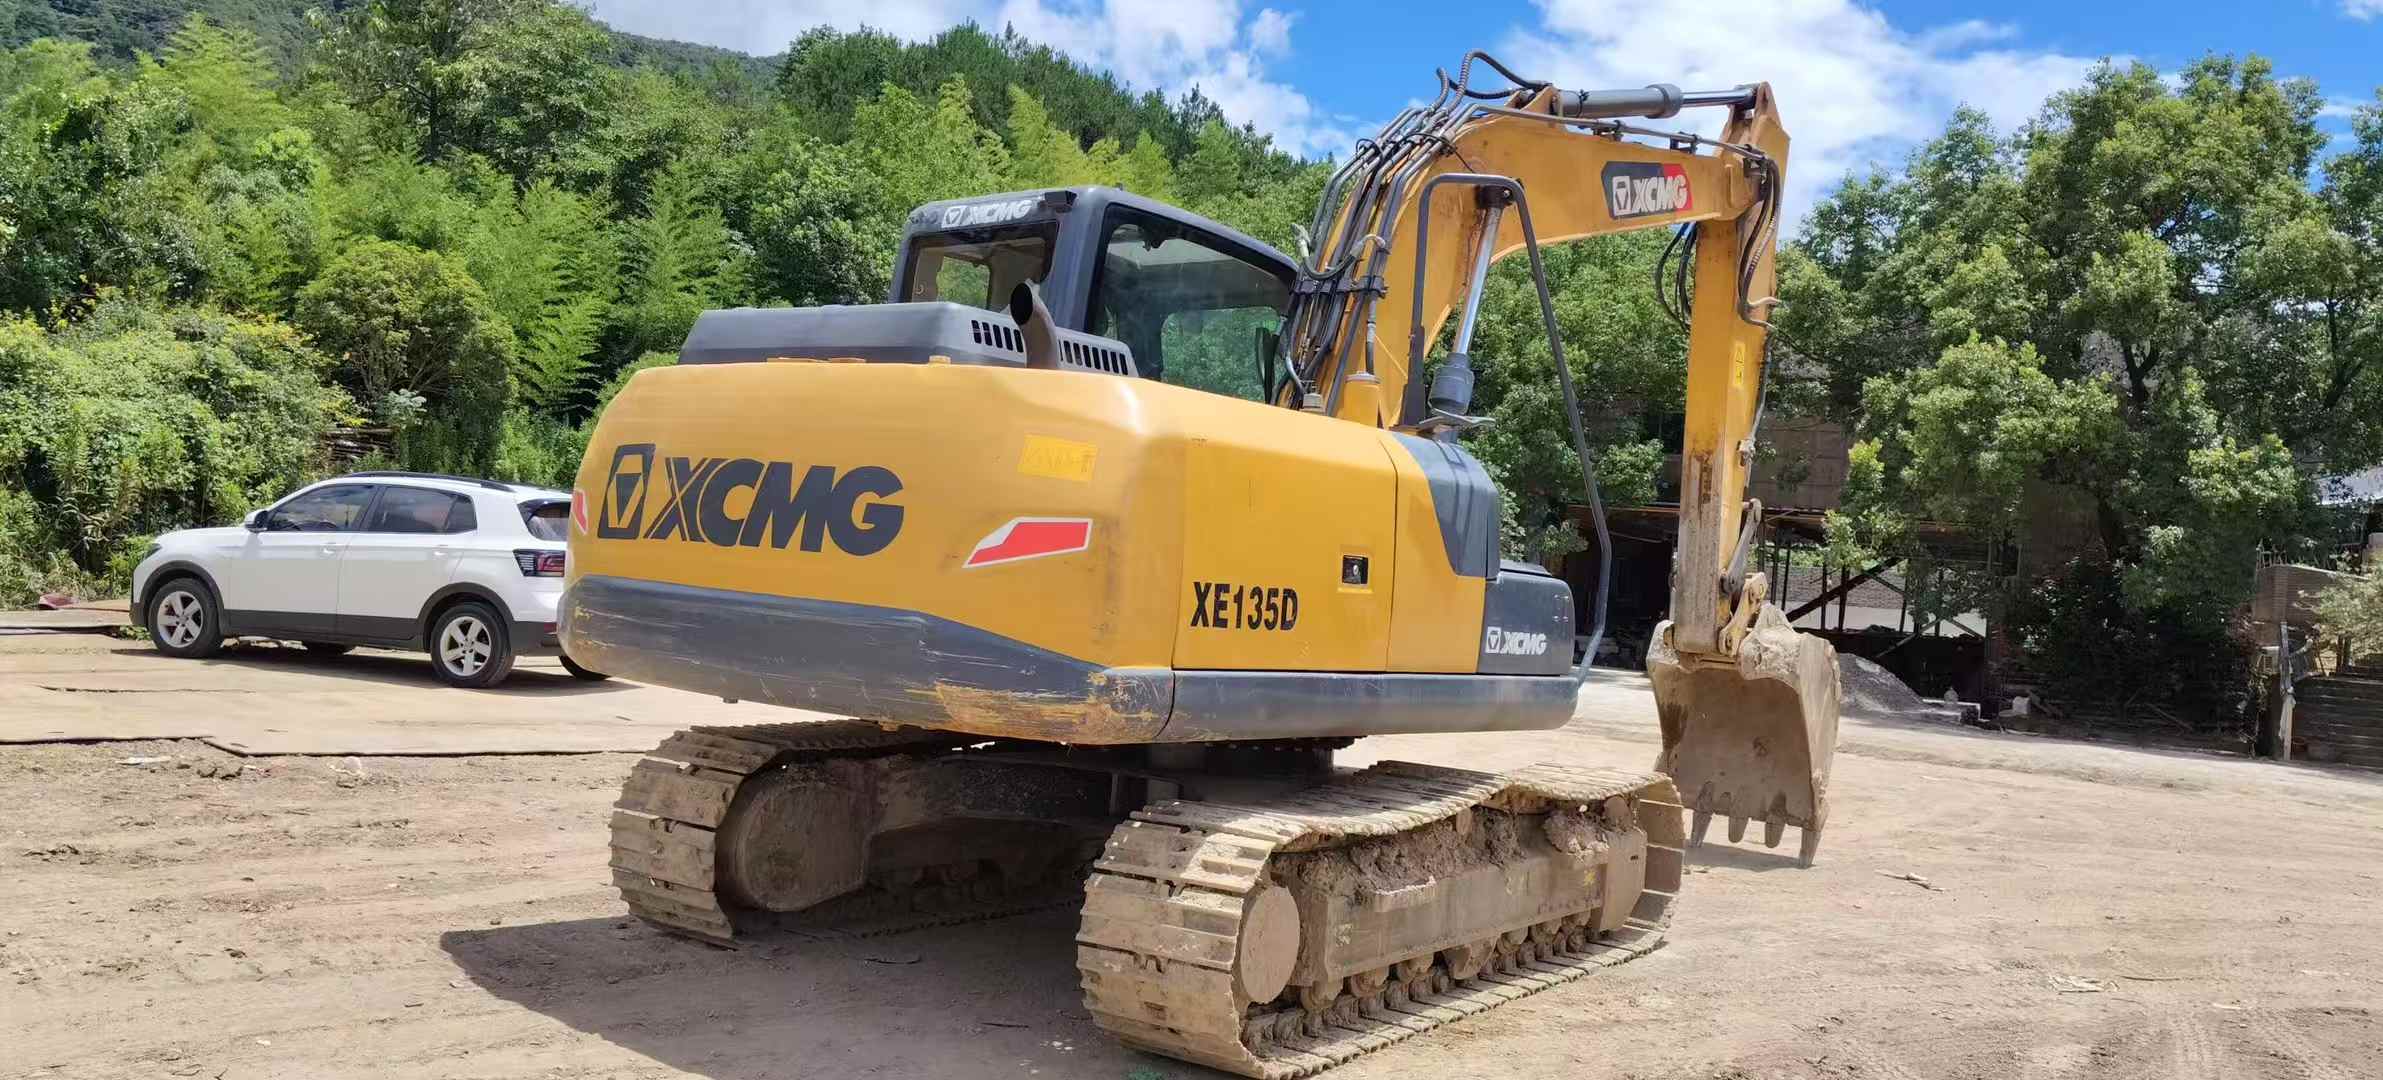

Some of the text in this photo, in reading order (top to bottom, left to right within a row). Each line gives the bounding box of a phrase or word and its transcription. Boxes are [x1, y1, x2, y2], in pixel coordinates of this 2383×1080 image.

[961, 199, 1033, 224] XCMG
[1632, 174, 1688, 212] XCMG
[643, 456, 905, 556] XCMG
[1190, 581, 1298, 631] XE135D
[1500, 631, 1547, 655] XCMG
